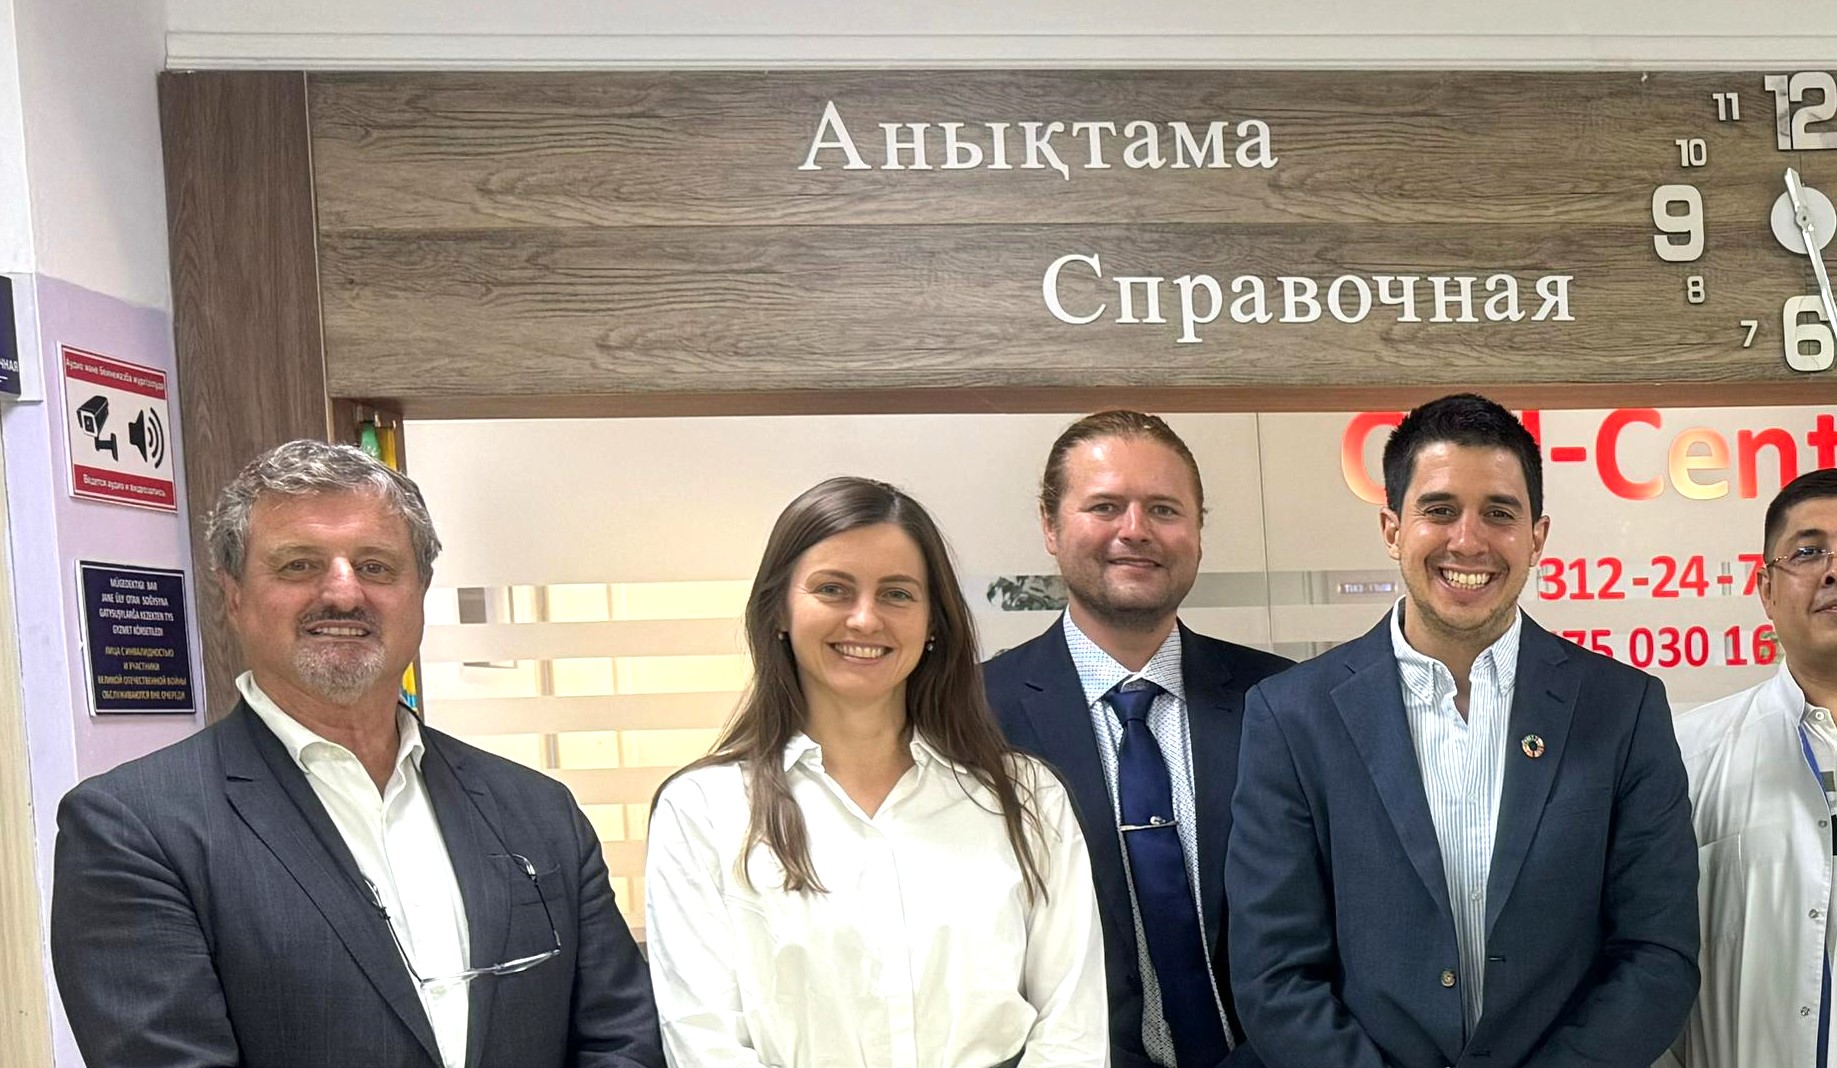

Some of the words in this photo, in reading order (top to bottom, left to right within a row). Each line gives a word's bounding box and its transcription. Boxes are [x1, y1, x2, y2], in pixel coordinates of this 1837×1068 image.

[1712, 92, 1740, 121] 11
[797, 99, 1279, 181] Анықтама
[1675, 138, 1707, 167] 10
[1652, 184, 1705, 262] 9
[1042, 253, 1576, 344] Справочная
[1686, 275, 1706, 304] 8
[1740, 320, 1758, 347] 7
[1782, 295, 1835, 371] 6
[1629, 625, 1709, 668] 030
